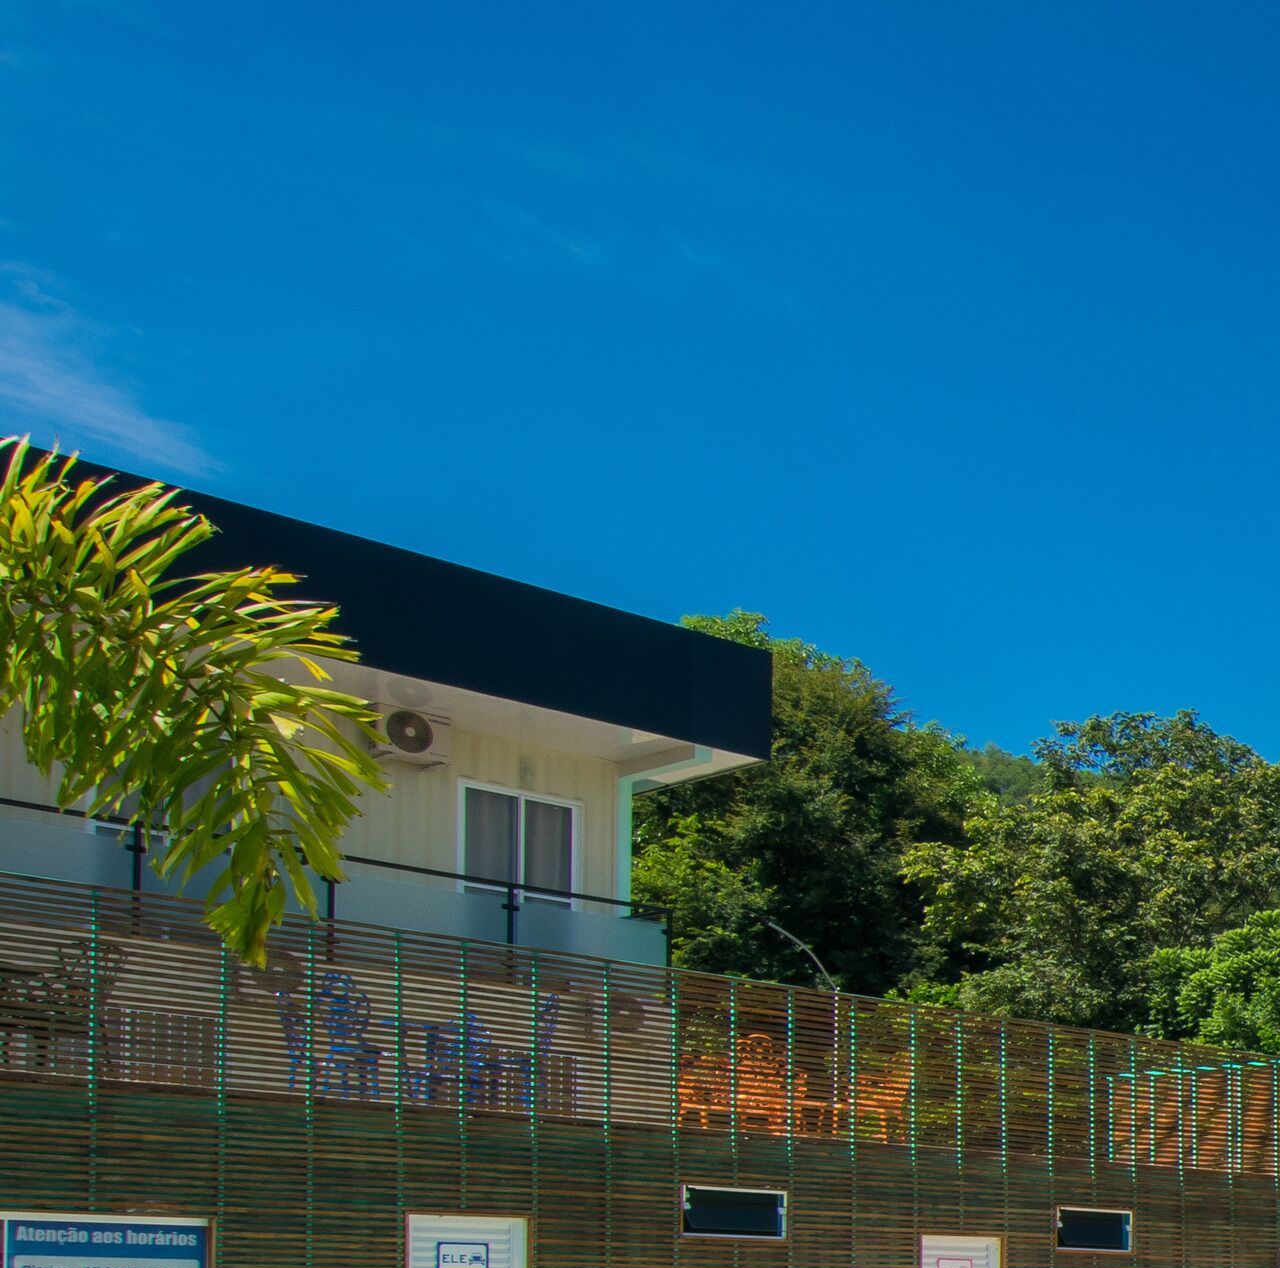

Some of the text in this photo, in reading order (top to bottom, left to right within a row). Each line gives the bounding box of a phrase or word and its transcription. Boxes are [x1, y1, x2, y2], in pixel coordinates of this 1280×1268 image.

[16, 1226, 197, 1246] Atenção aos horários
[442, 1254, 467, 1263] ELE
